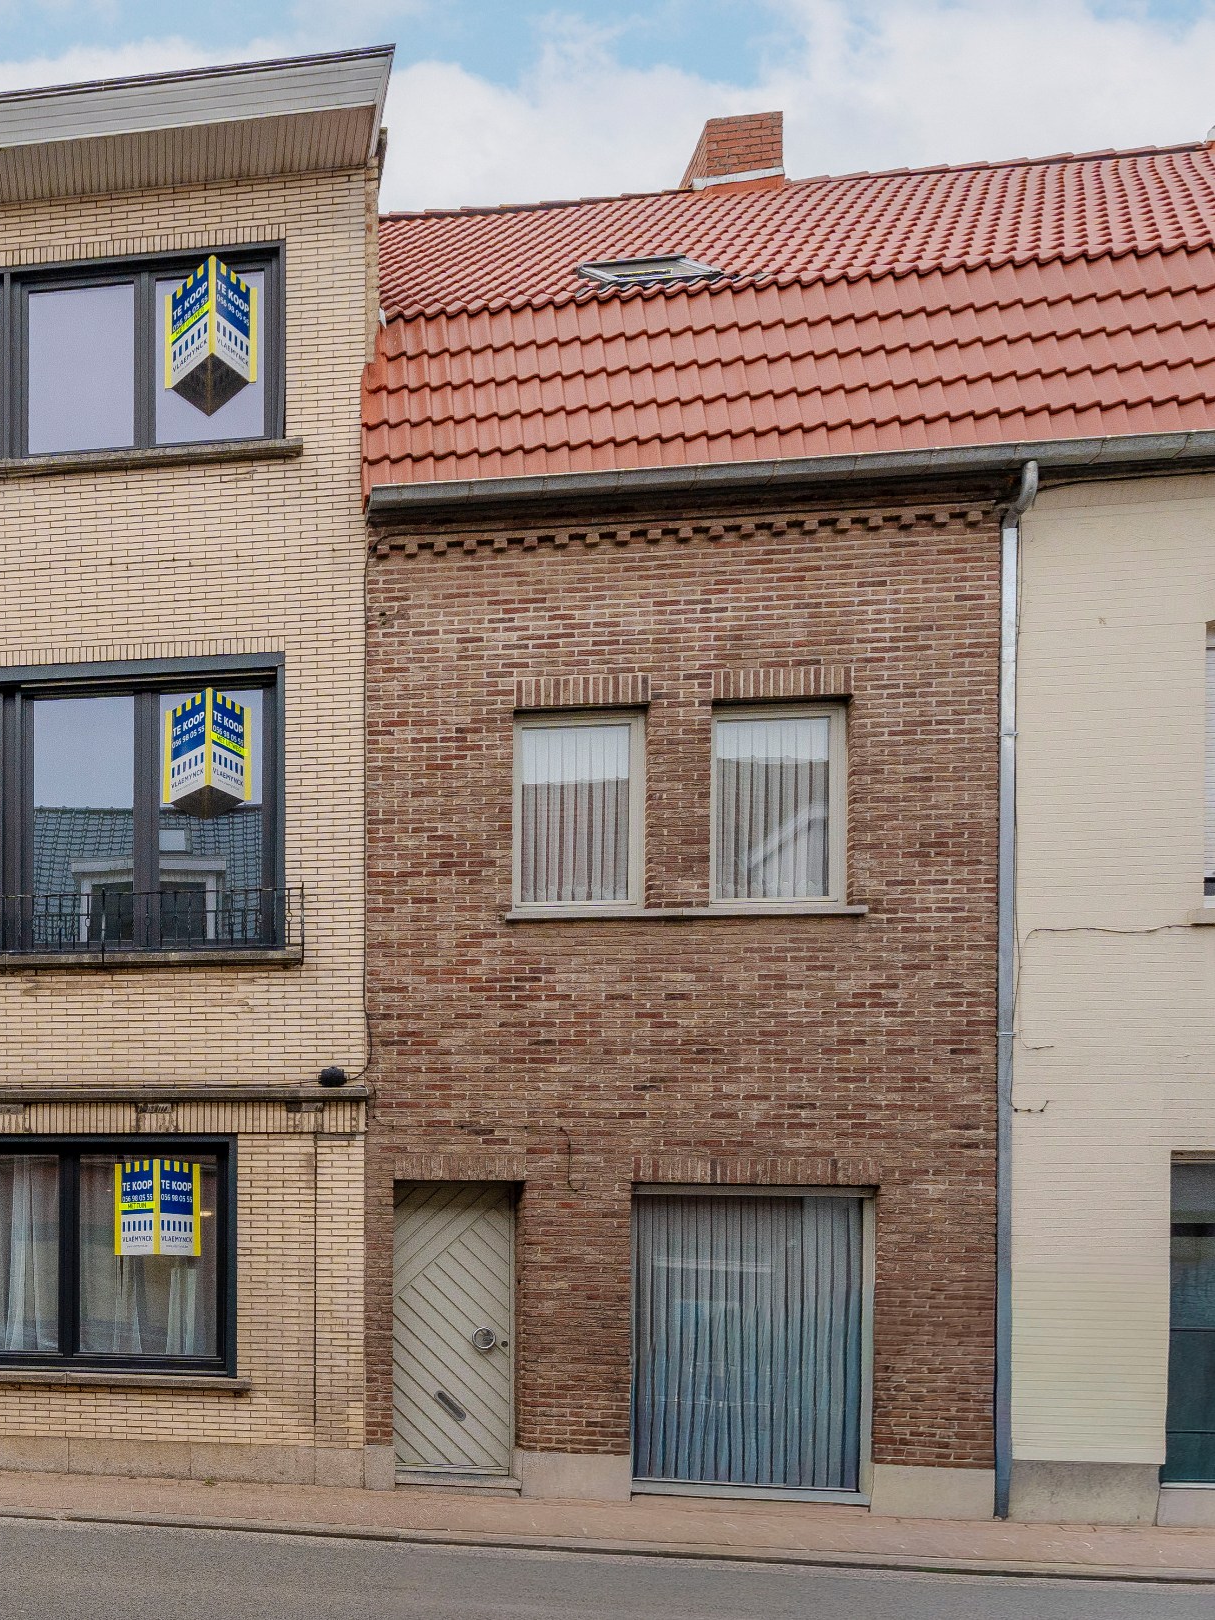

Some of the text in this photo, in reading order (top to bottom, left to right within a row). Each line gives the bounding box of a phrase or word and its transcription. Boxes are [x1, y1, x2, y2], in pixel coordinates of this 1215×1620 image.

[173, 282, 208, 320] TE KOOP
[217, 279, 249, 312] TE KOOP
[173, 339, 207, 372] VLAEMYNCK
[217, 336, 249, 367] VLAEMYNCK
[173, 711, 204, 737] TE KOOP
[213, 711, 243, 733] TE KOOP
[213, 725, 222, 736] 056
[172, 738, 181, 748] 056
[182, 734, 189, 742] 98
[190, 730, 197, 739] 05
[171, 768, 204, 788] VLAEMYNCK
[213, 767, 243, 787] VLAEMYNCK
[122, 1180, 152, 1191] TE KOOP
[161, 1180, 192, 1191] TE KOOP
